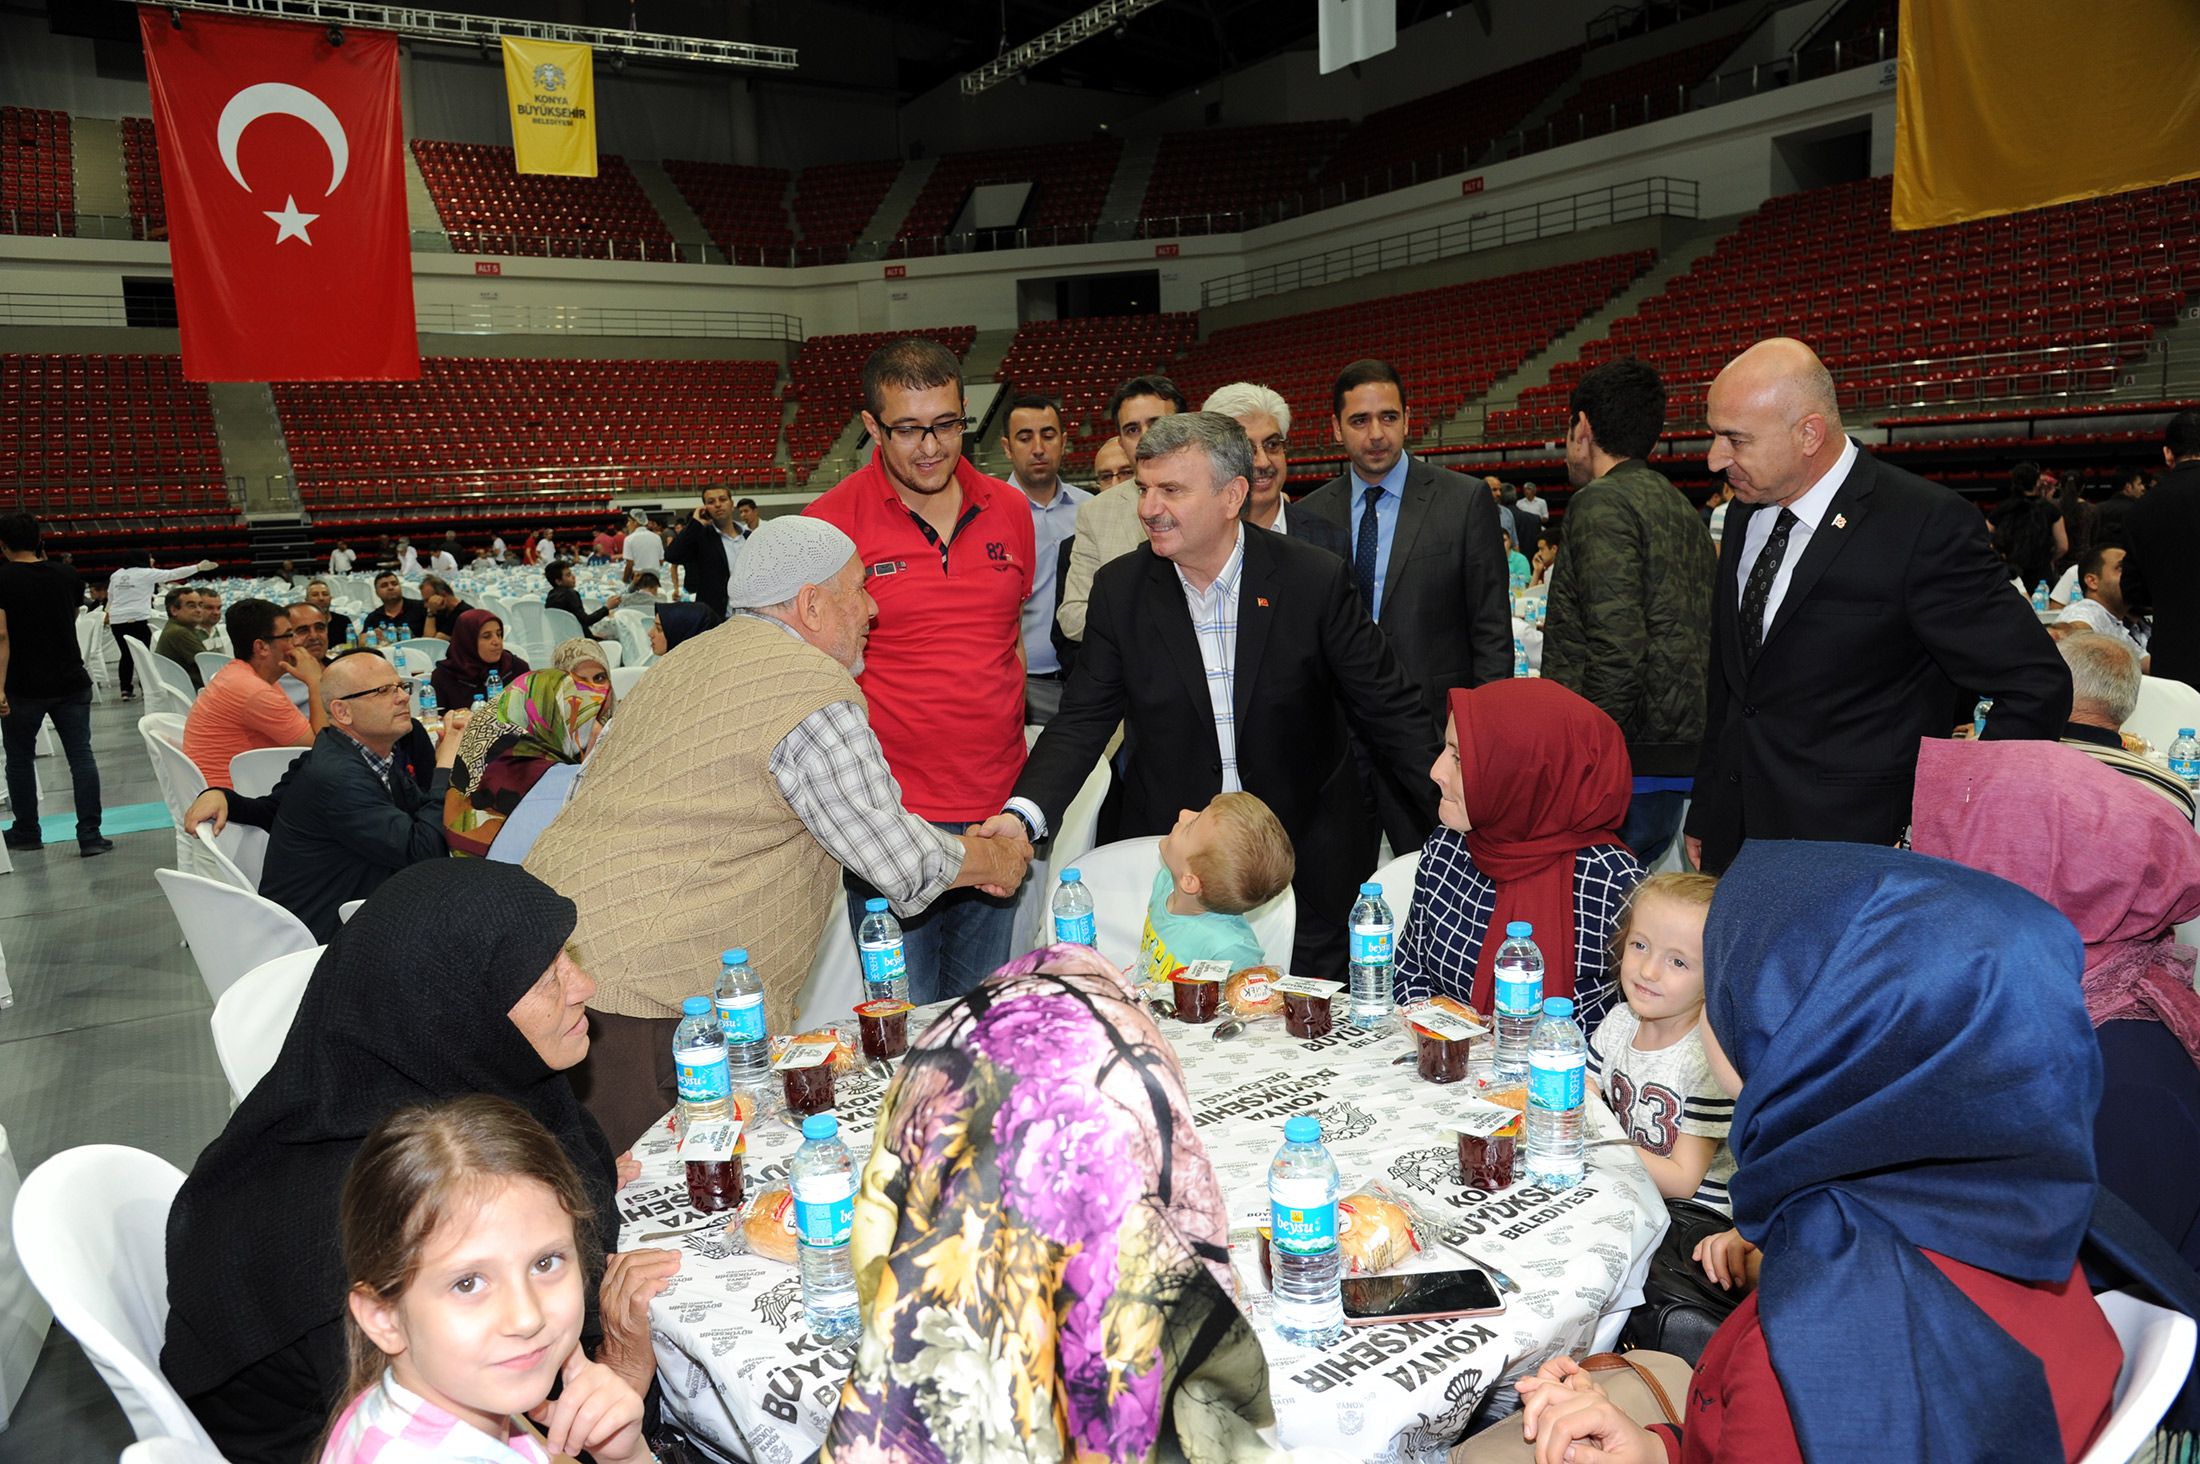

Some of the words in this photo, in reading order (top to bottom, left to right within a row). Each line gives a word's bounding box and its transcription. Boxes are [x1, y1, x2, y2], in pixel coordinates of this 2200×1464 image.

[517, 102, 587, 119] BÜYÜKŞEHİR
[534, 94, 568, 105] KONYA
[1244, 1091, 1331, 1122] KONYA
[1277, 1213, 1314, 1235] beysu
[1499, 1187, 1600, 1241] BELEDİYESİ
[1382, 1323, 1499, 1393] KONYA
